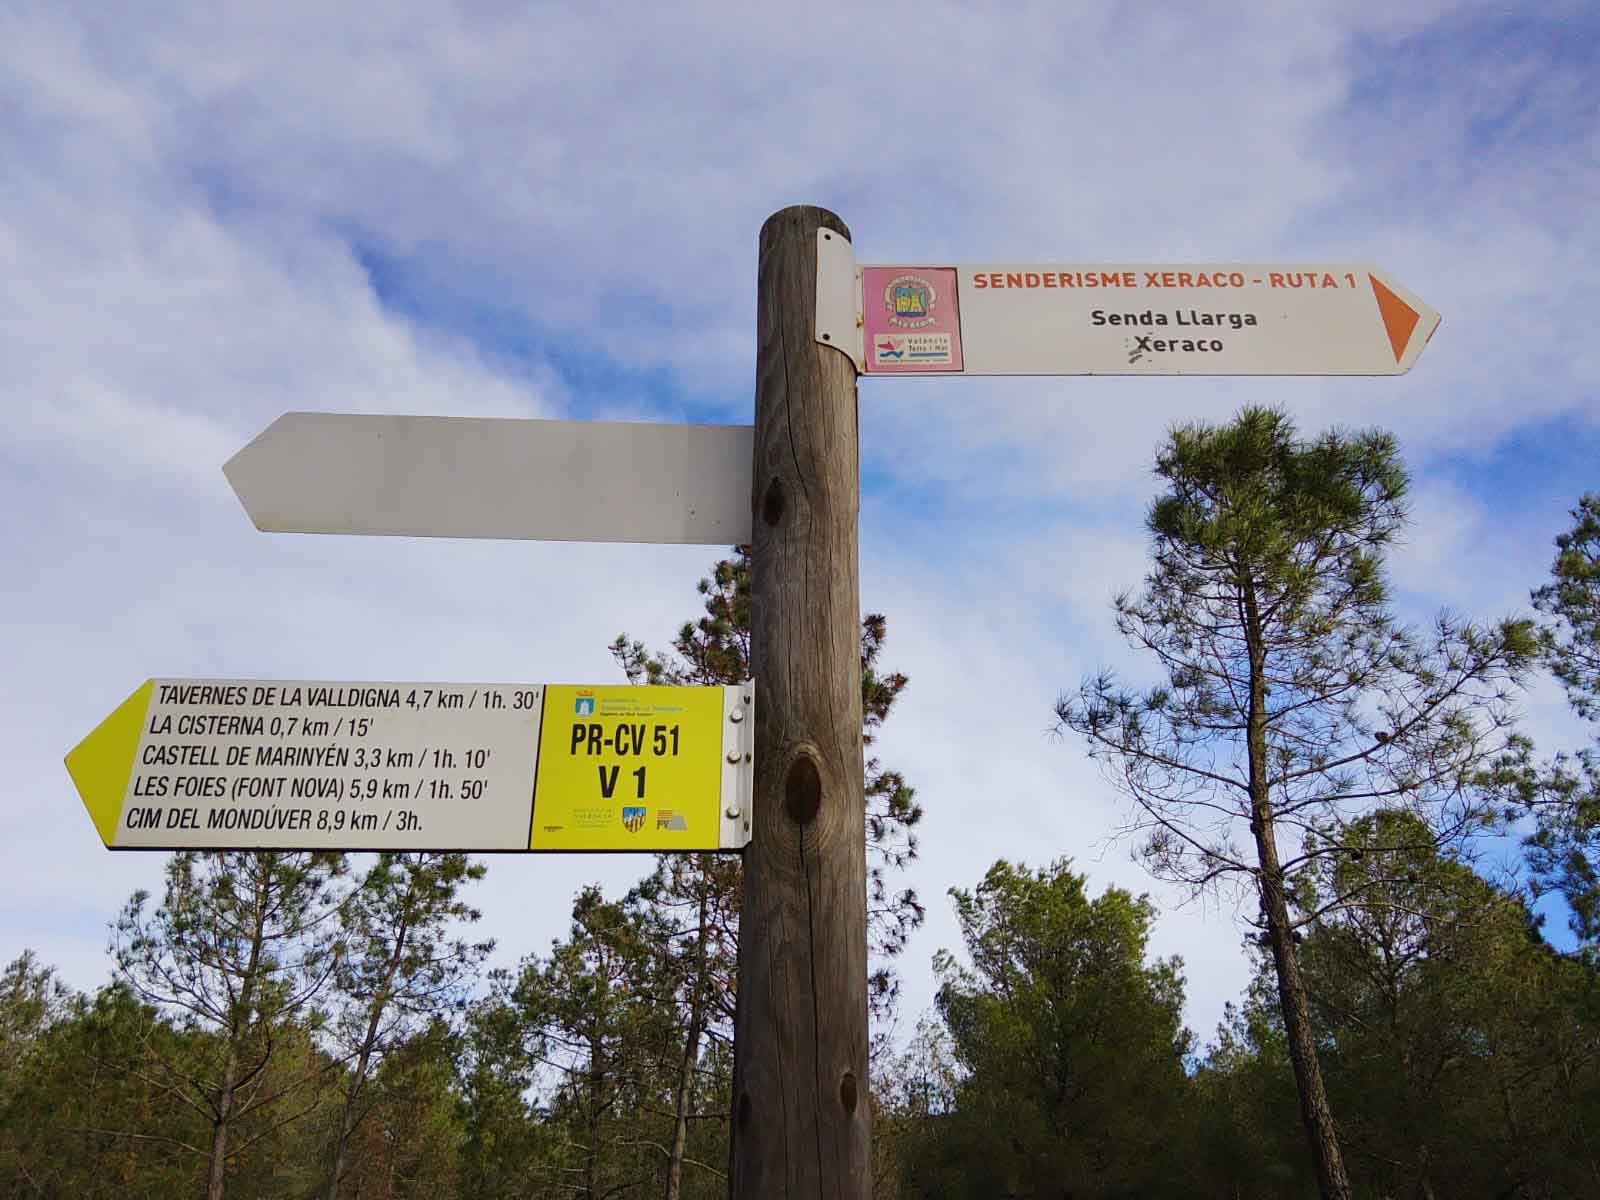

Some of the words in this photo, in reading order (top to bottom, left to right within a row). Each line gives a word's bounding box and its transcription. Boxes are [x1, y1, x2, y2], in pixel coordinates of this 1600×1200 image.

[974, 272, 1137, 289] SENDERISME
[1145, 272, 1244, 288] XERACO
[1271, 273, 1338, 288] RUTA
[1345, 273, 1356, 288] 1
[1091, 310, 1168, 326] Senda
[1176, 310, 1257, 329] Llarga
[1135, 336, 1223, 352] Xeraco
[159, 685, 248, 705] TAVERNES
[252, 687, 276, 705] DE
[280, 688, 301, 706] LA
[308, 688, 400, 707] VALLDIGNA
[406, 690, 433, 711] 4,7
[438, 690, 463, 708] km
[483, 691, 506, 709] 1h.
[513, 691, 539, 709] 30'
[150, 715, 172, 734] LA
[178, 715, 264, 735] CISTERNA
[270, 717, 298, 739] 0,7
[302, 718, 328, 736] km
[348, 718, 374, 736] 15'
[571, 724, 646, 756] PR-CV
[653, 725, 679, 756] 51
[143, 745, 219, 765] CASTELL
[226, 746, 251, 765] DE
[255, 743, 348, 767] MARINYÉN
[354, 748, 381, 769] 3,3
[386, 749, 413, 767] km
[433, 749, 456, 768] 1h.
[465, 749, 490, 768] 10'
[134, 776, 169, 796] LES
[174, 776, 226, 797] FOIES
[232, 777, 287, 801] (FONT
[291, 778, 344, 802] NOVA)
[350, 779, 378, 801] 5,9
[383, 779, 409, 798] km
[429, 780, 453, 799] 1h.
[461, 780, 488, 799] 50'
[599, 766, 620, 798] V
[633, 766, 646, 798] 1
[126, 808, 162, 828] CIM
[166, 808, 200, 828] DEL
[207, 804, 311, 830] MONDÚVER
[317, 810, 345, 833] 8,9
[351, 810, 378, 830] km
[396, 811, 422, 830] 3h.
